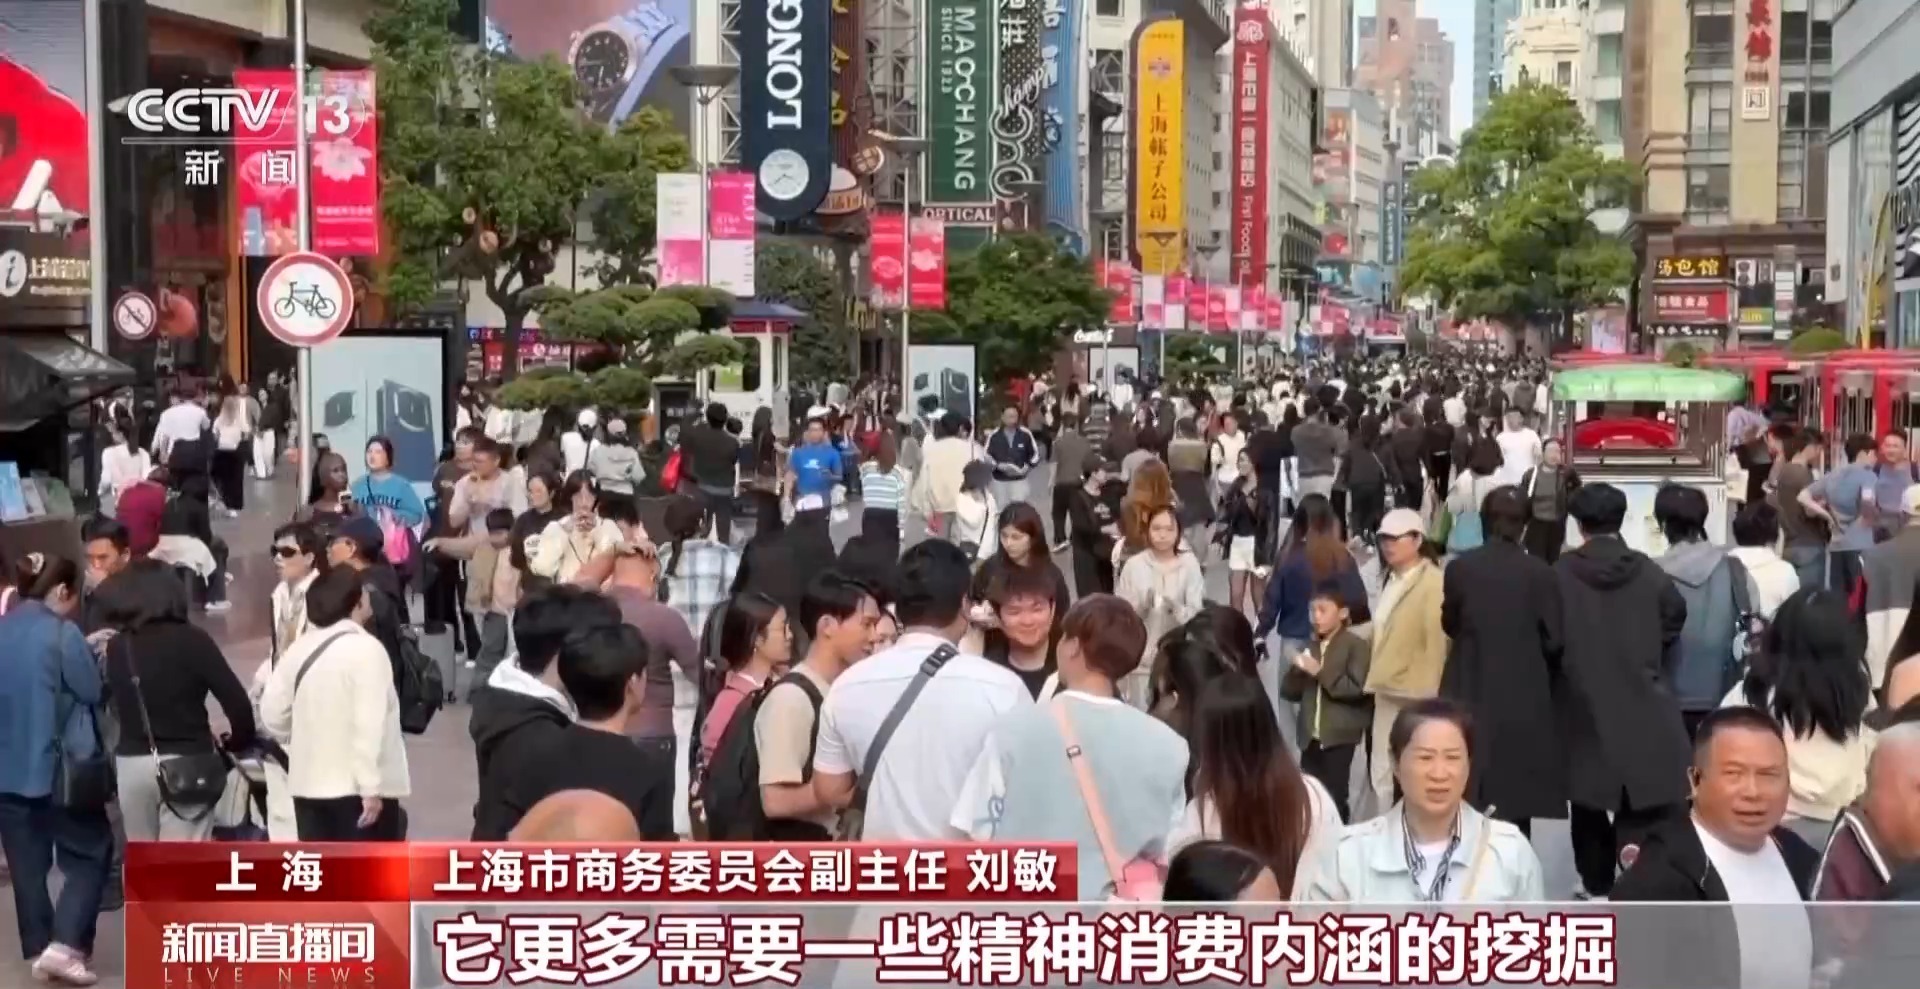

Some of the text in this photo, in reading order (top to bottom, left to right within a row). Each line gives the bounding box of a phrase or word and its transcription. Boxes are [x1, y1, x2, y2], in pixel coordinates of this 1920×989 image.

[941, 7, 953, 51] SINCE
[766, 0, 803, 129] LONG
[923, 207, 995, 222] OPTICAL
[1658, 258, 1720, 277] 汤包馆
